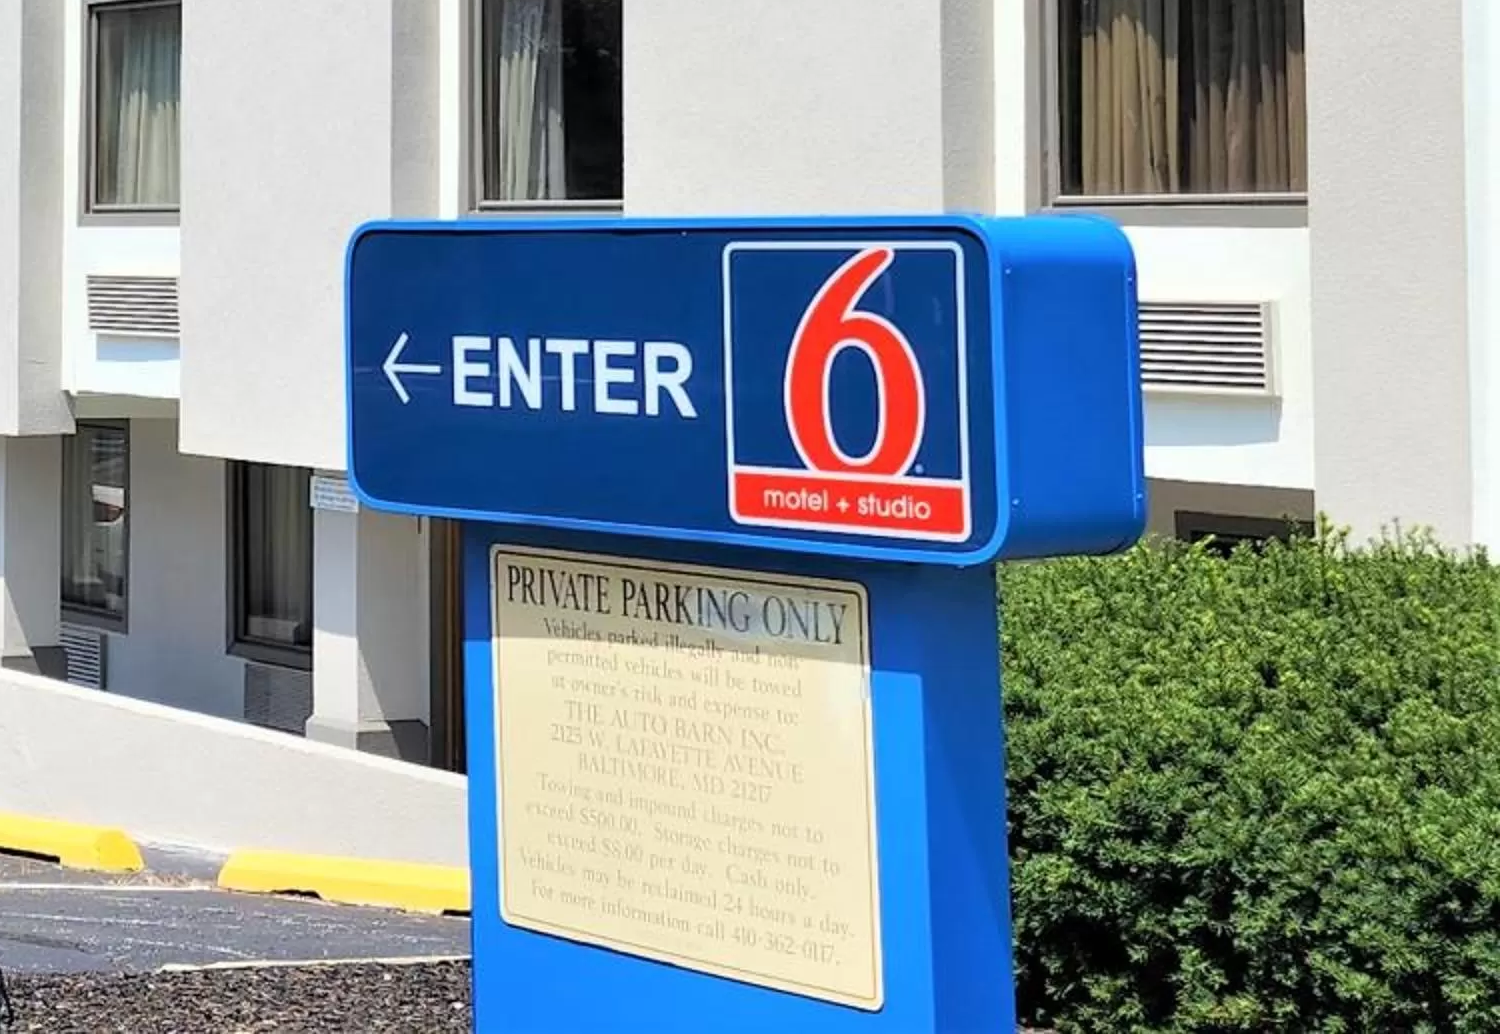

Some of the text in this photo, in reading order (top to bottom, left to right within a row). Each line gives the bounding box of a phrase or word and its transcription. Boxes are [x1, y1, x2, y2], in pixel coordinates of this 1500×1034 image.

[452, 335, 699, 418] ENTER
[784, 246, 925, 478] 6
[763, 487, 829, 512] motel
[857, 493, 932, 520] studio
[508, 565, 847, 645] PRIVATE PARKING ONLY
[543, 617, 602, 642] Vehicles
[607, 629, 659, 650] parked
[547, 649, 803, 698] permitted vehicles will be towed
[563, 699, 605, 726] THE
[609, 709, 670, 736] AUTO
[674, 717, 734, 746] BARN
[668, 690, 698, 711] and
[703, 698, 770, 723] expense
[616, 734, 716, 770] LAFAYETTE
[722, 753, 804, 784] AVENUE
[536, 771, 825, 844] Towing and impound charges not to
[692, 773, 726, 796] MD
[649, 851, 677, 873] per
[725, 863, 769, 889] Cash
[652, 822, 713, 851] Storage
[717, 836, 781, 865] charges
[786, 852, 816, 872] not
[820, 856, 843, 878] to
[519, 845, 576, 875] Vehicles
[722, 892, 743, 915] 24
[748, 895, 797, 927] hours
[599, 895, 691, 932] information
[696, 916, 726, 943] call
